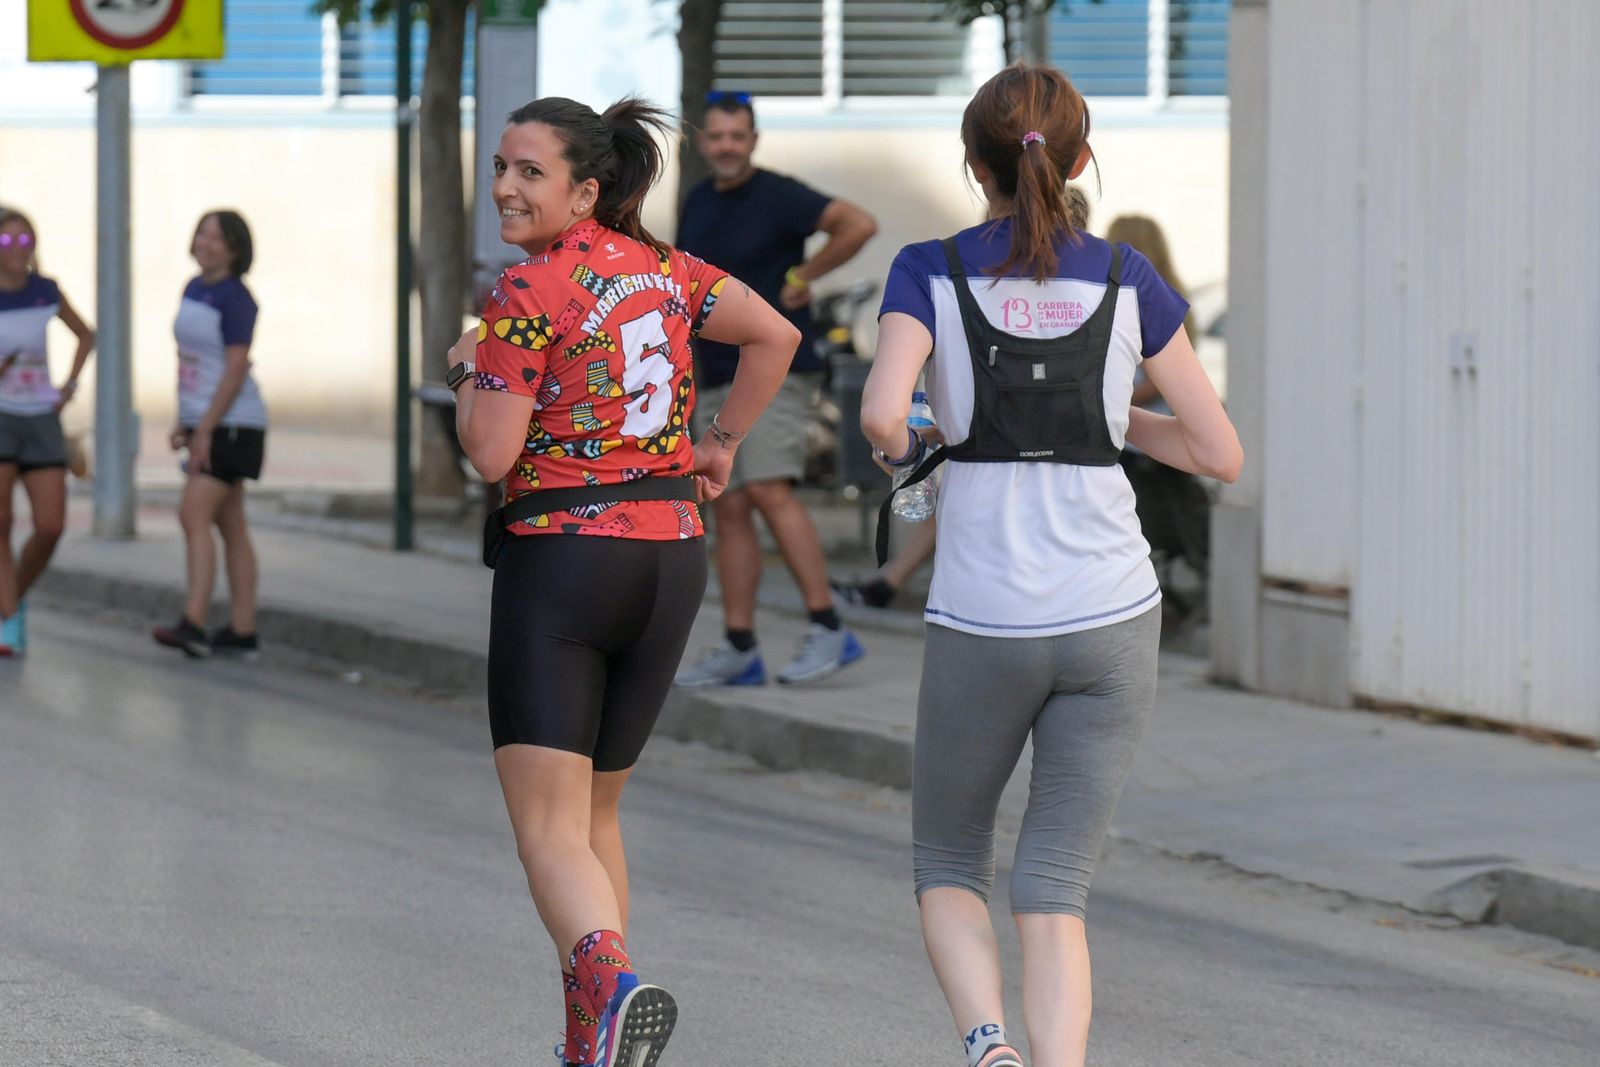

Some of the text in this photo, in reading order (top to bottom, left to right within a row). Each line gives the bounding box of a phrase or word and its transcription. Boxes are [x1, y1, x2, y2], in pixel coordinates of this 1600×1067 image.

[1001, 297, 1033, 329] 13
[1037, 301, 1083, 310] CARRERA
[1045, 310, 1083, 321] MUJER
[618, 308, 675, 439] 5
